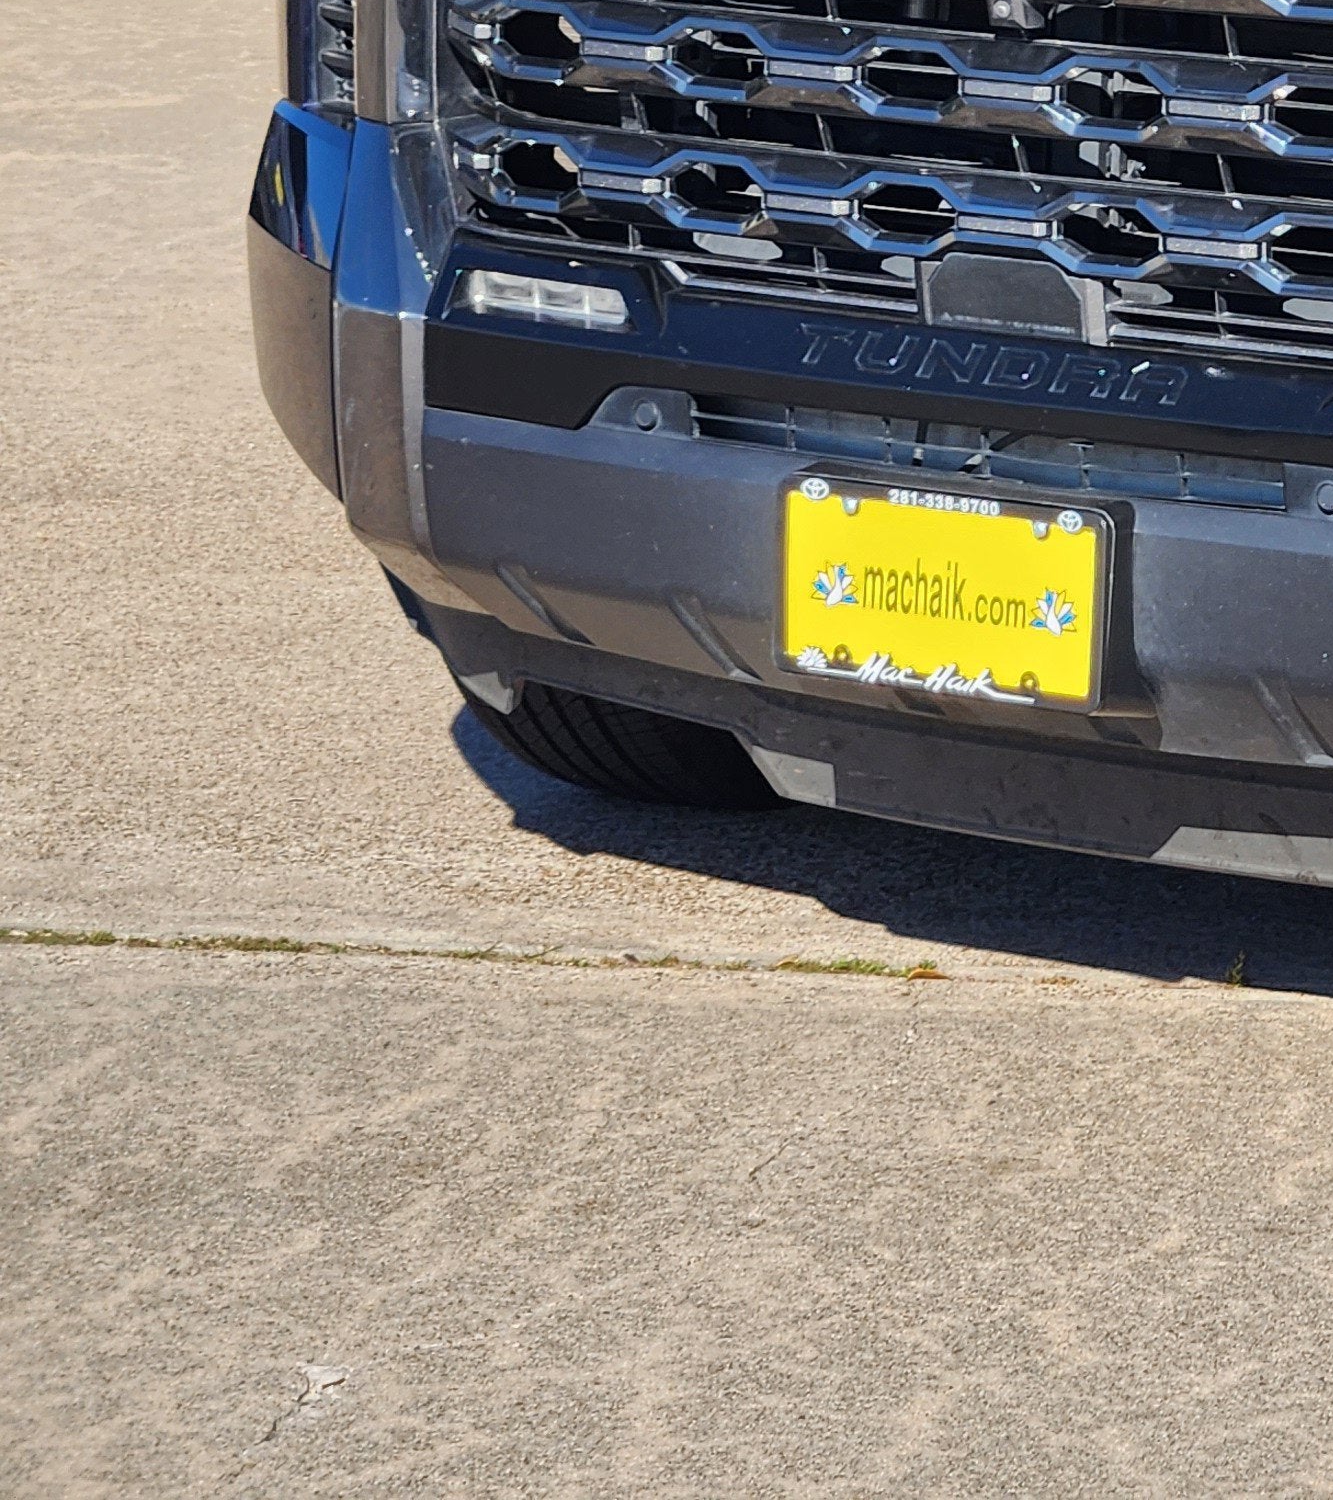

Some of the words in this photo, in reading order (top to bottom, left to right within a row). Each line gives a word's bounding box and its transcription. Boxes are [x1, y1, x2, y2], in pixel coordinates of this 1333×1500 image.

[800, 321, 1189, 406] TUNDRA
[887, 487, 1001, 517] 281-338-9700
[863, 558, 1026, 629] machaik.com
[857, 651, 922, 684] Mac
[922, 663, 998, 695] Haik
